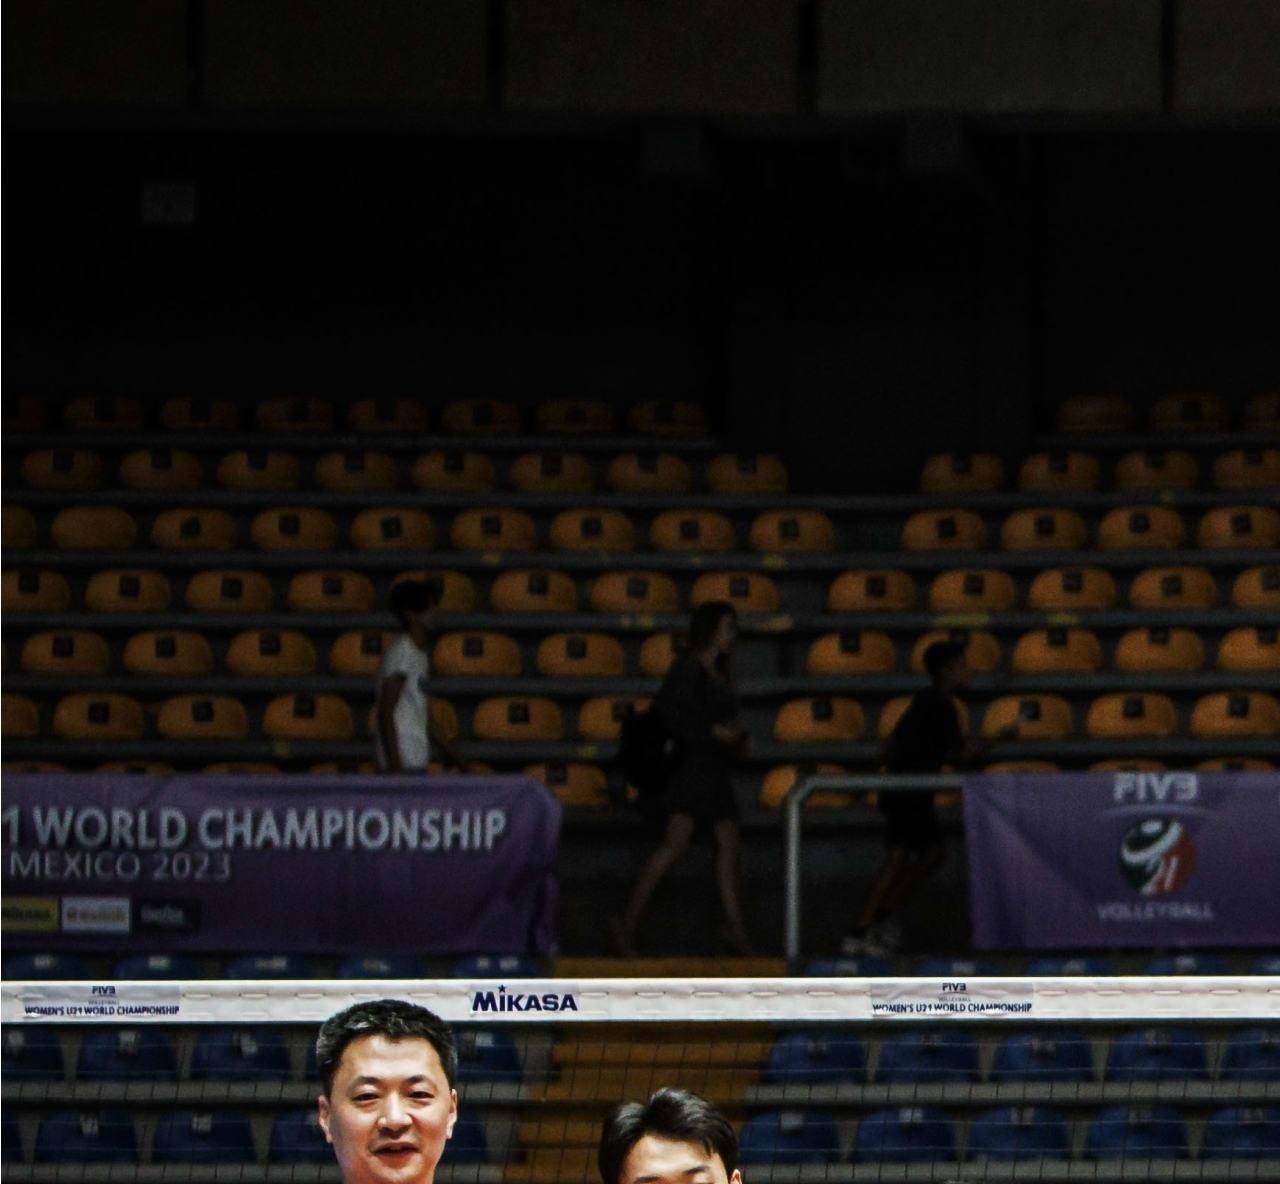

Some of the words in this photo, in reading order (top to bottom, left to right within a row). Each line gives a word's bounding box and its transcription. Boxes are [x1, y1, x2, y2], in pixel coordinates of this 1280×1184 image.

[33, 806, 188, 849] WORLD
[199, 807, 507, 852] CHAMPIONSHIP
[10, 852, 141, 880] MEXICO
[152, 852, 231, 881] 2023
[92, 986, 115, 994] FIVB
[942, 983, 966, 991] FIVB
[472, 986, 578, 1012] MIKASA
[25, 1006, 64, 1015] WOMEN'S
[66, 1006, 82, 1015] U21
[84, 1006, 115, 1015] WORLD
[117, 1006, 179, 1015] CHAMPIONSHIP
[873, 1004, 914, 1013] WOMEN'S
[916, 1004, 933, 1013] U21
[934, 1004, 965, 1013] WORLD
[967, 1004, 1032, 1013] CHAMPIONSHIP
